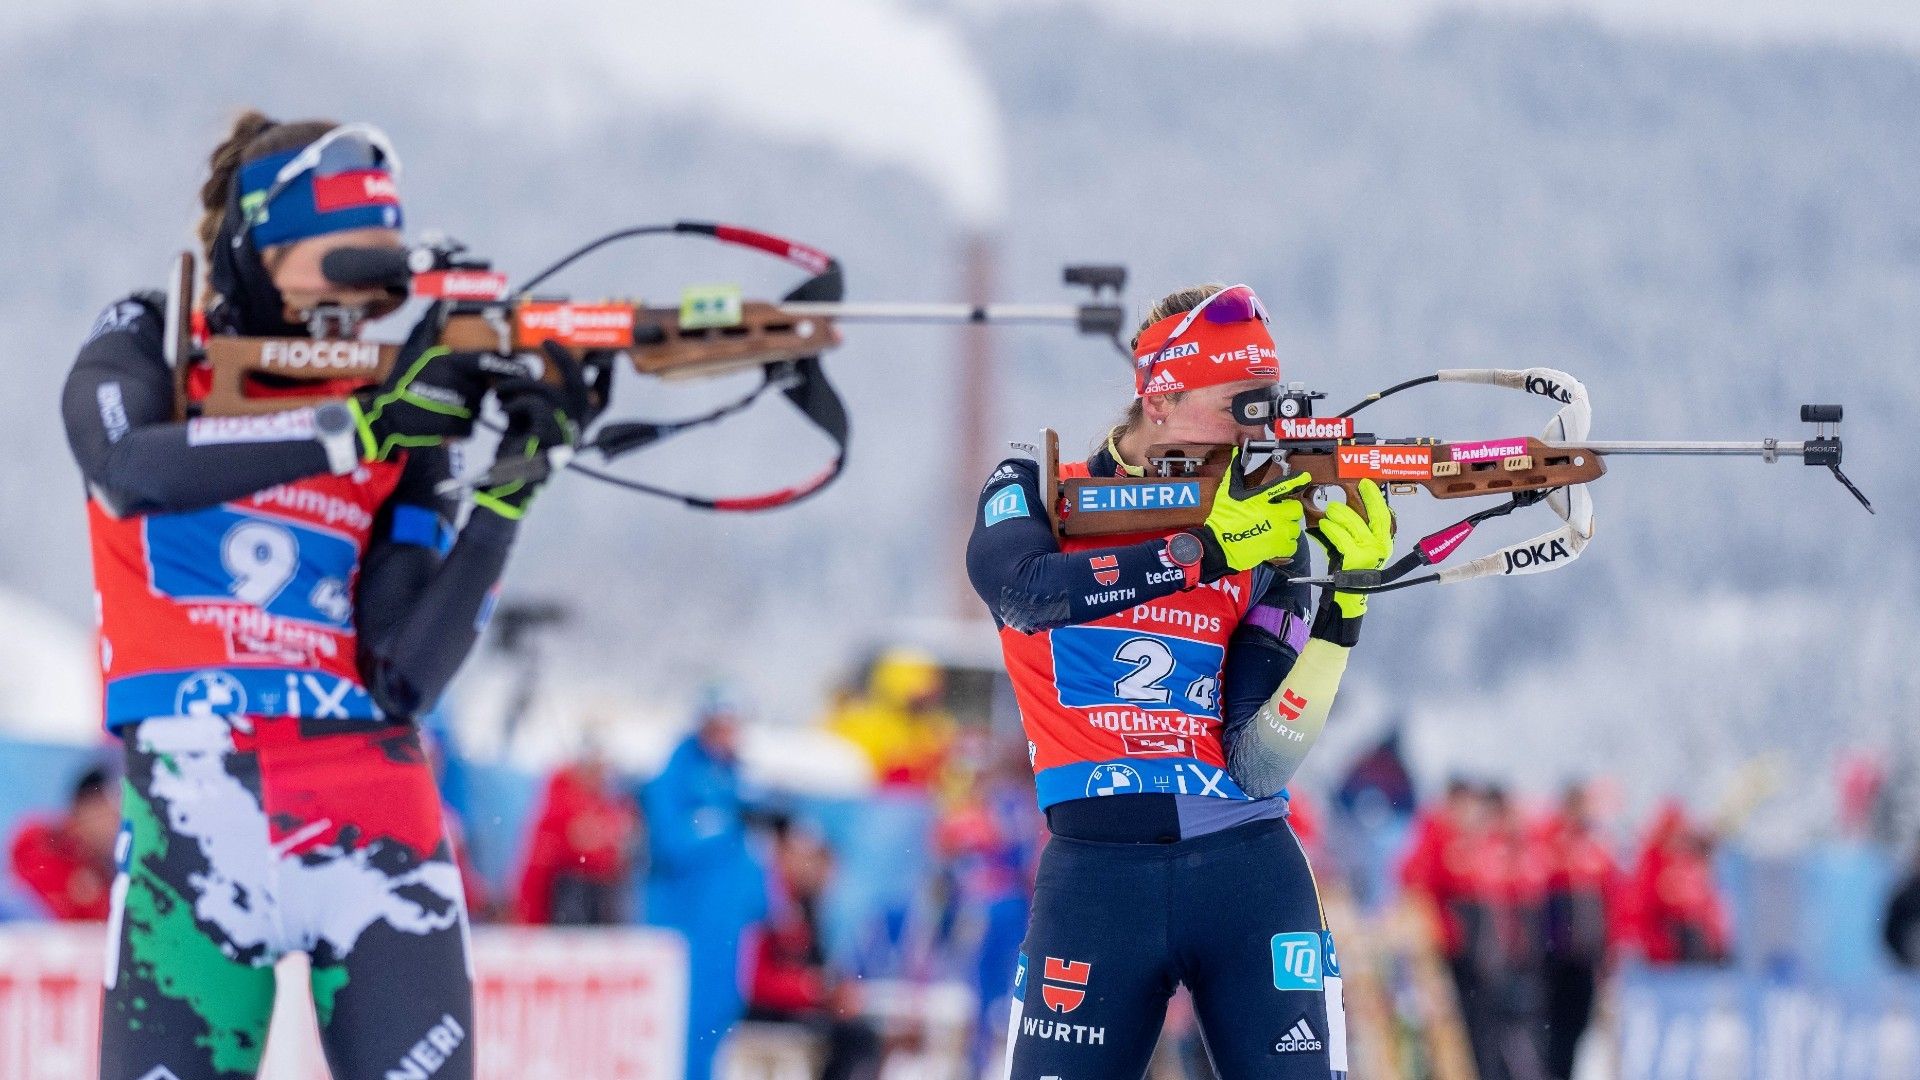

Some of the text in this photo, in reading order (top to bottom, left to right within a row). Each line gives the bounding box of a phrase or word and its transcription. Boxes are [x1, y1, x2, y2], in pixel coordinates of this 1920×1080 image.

[261, 341, 379, 368] FIOCCHI
[1145, 381, 1185, 394] adidas
[1281, 418, 1346, 438] Nudossi
[1341, 449, 1429, 470] VIESSMANN
[1452, 444, 1523, 461] HANDWERK
[1082, 485, 1196, 509] E.INFRA
[1222, 519, 1272, 543] Roeckl
[220, 517, 352, 626] 9 4
[1145, 568, 1186, 585] tecta
[1084, 587, 1136, 606] WÜRTH
[1132, 604, 1221, 633] pumps
[1113, 636, 1218, 711] 2 4
[1262, 709, 1305, 743] WÜRTH
[1023, 1016, 1105, 1045] WÜRTH
[1275, 1039, 1322, 1053] adidas
